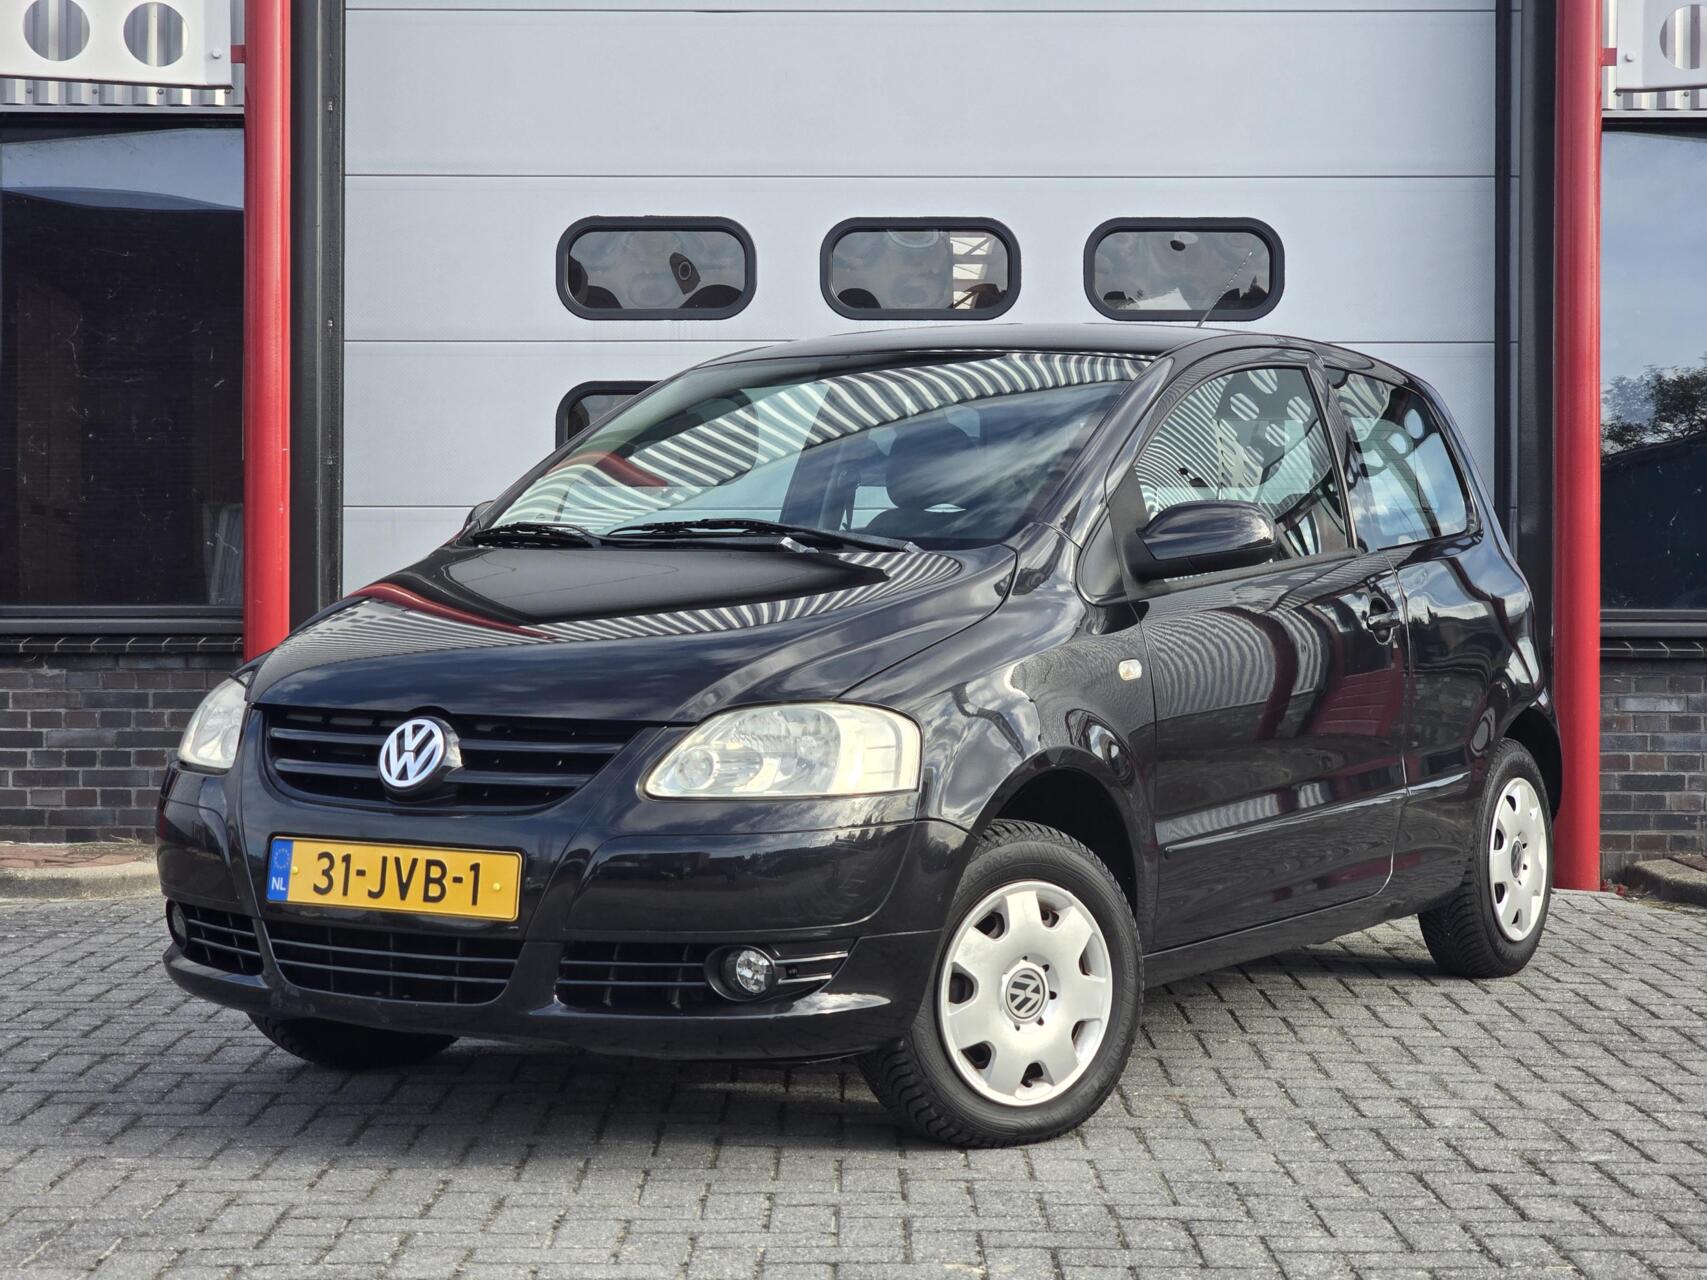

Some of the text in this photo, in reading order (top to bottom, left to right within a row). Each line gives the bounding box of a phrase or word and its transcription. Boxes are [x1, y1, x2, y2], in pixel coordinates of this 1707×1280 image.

[380, 719, 444, 787] VW
[271, 876, 286, 891] NL
[313, 851, 480, 906] 31-JVB-1
[1006, 969, 1044, 1018] VW
